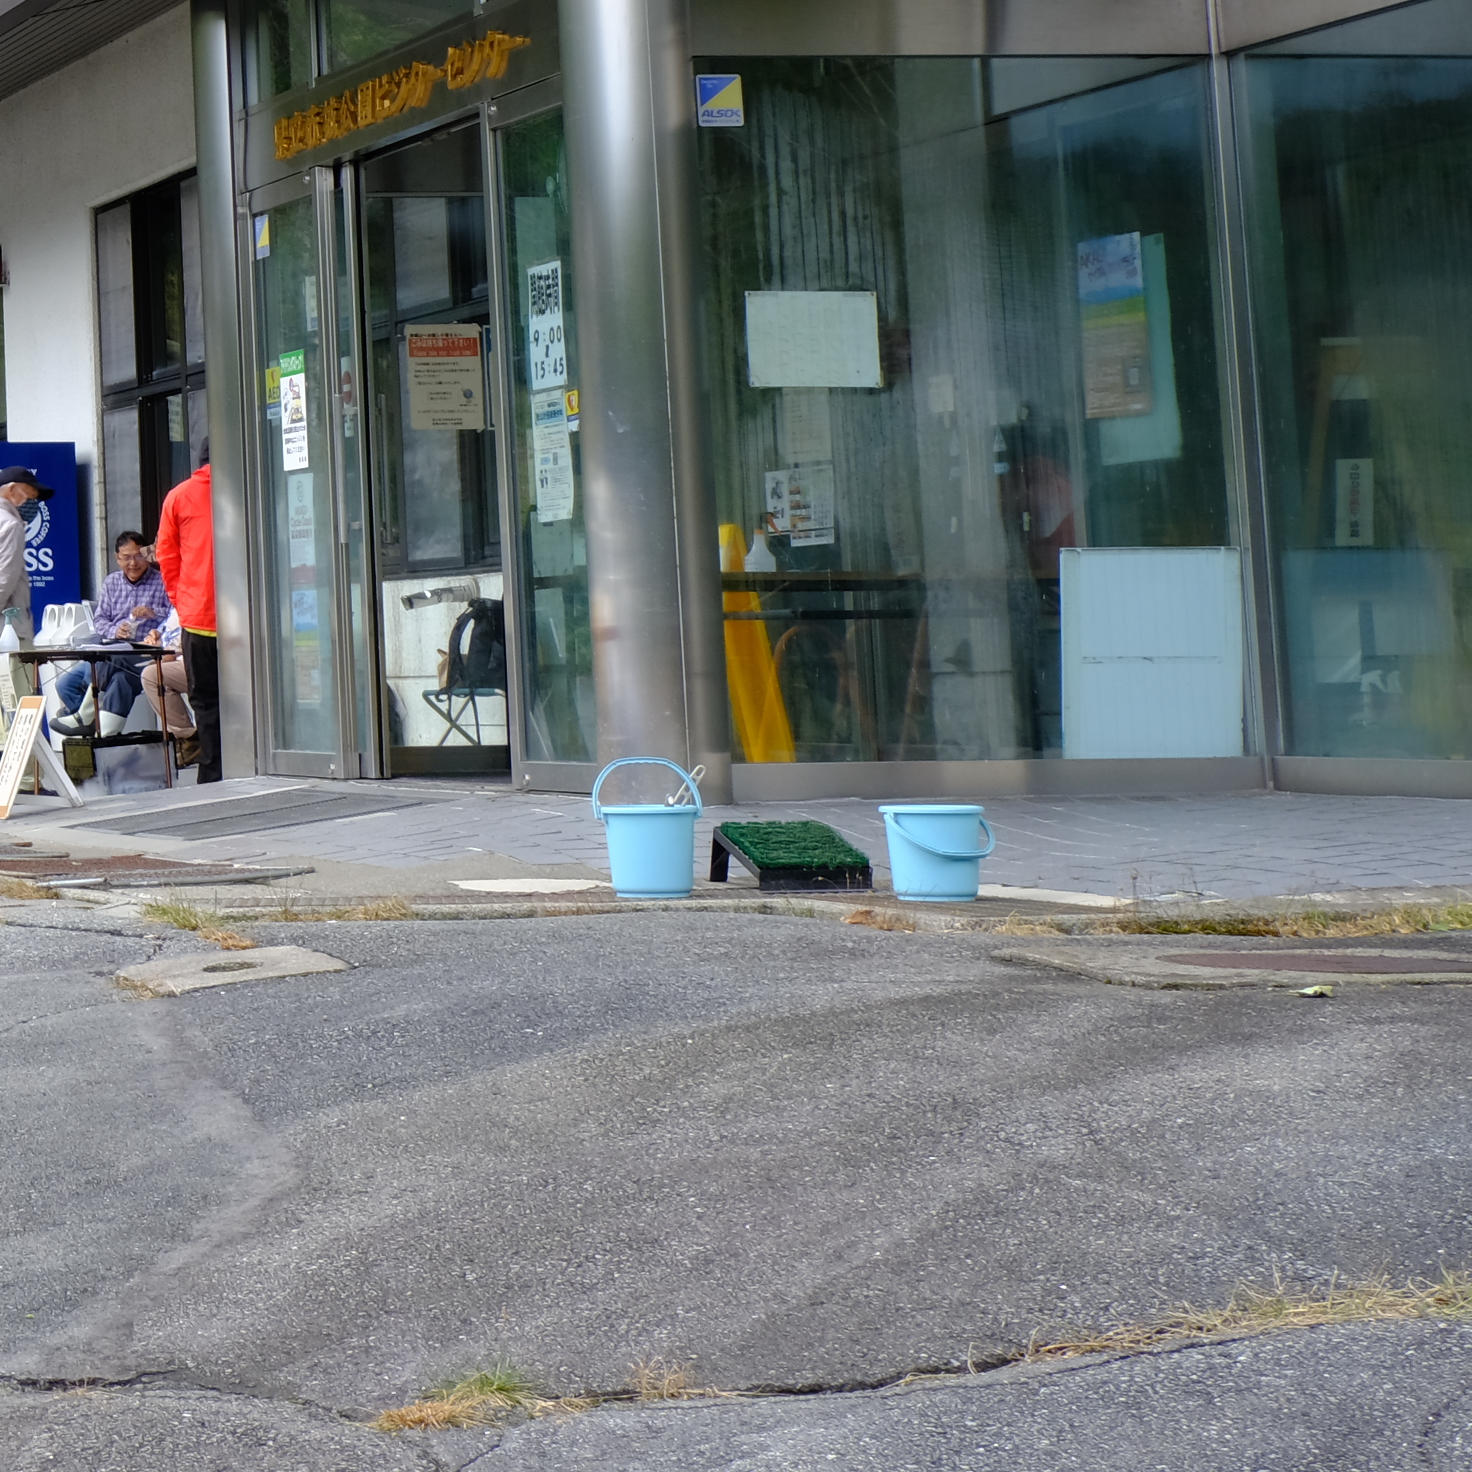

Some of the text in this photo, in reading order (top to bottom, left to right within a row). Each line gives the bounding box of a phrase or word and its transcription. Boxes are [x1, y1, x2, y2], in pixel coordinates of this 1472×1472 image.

[701, 109, 741, 118] ALSOK
[533, 325, 562, 347] 9:00
[534, 357, 564, 381] 15:45
[267, 386, 281, 401] AED
[31, 500, 50, 547] BOSS COFFEE
[23, 547, 54, 572] SS
